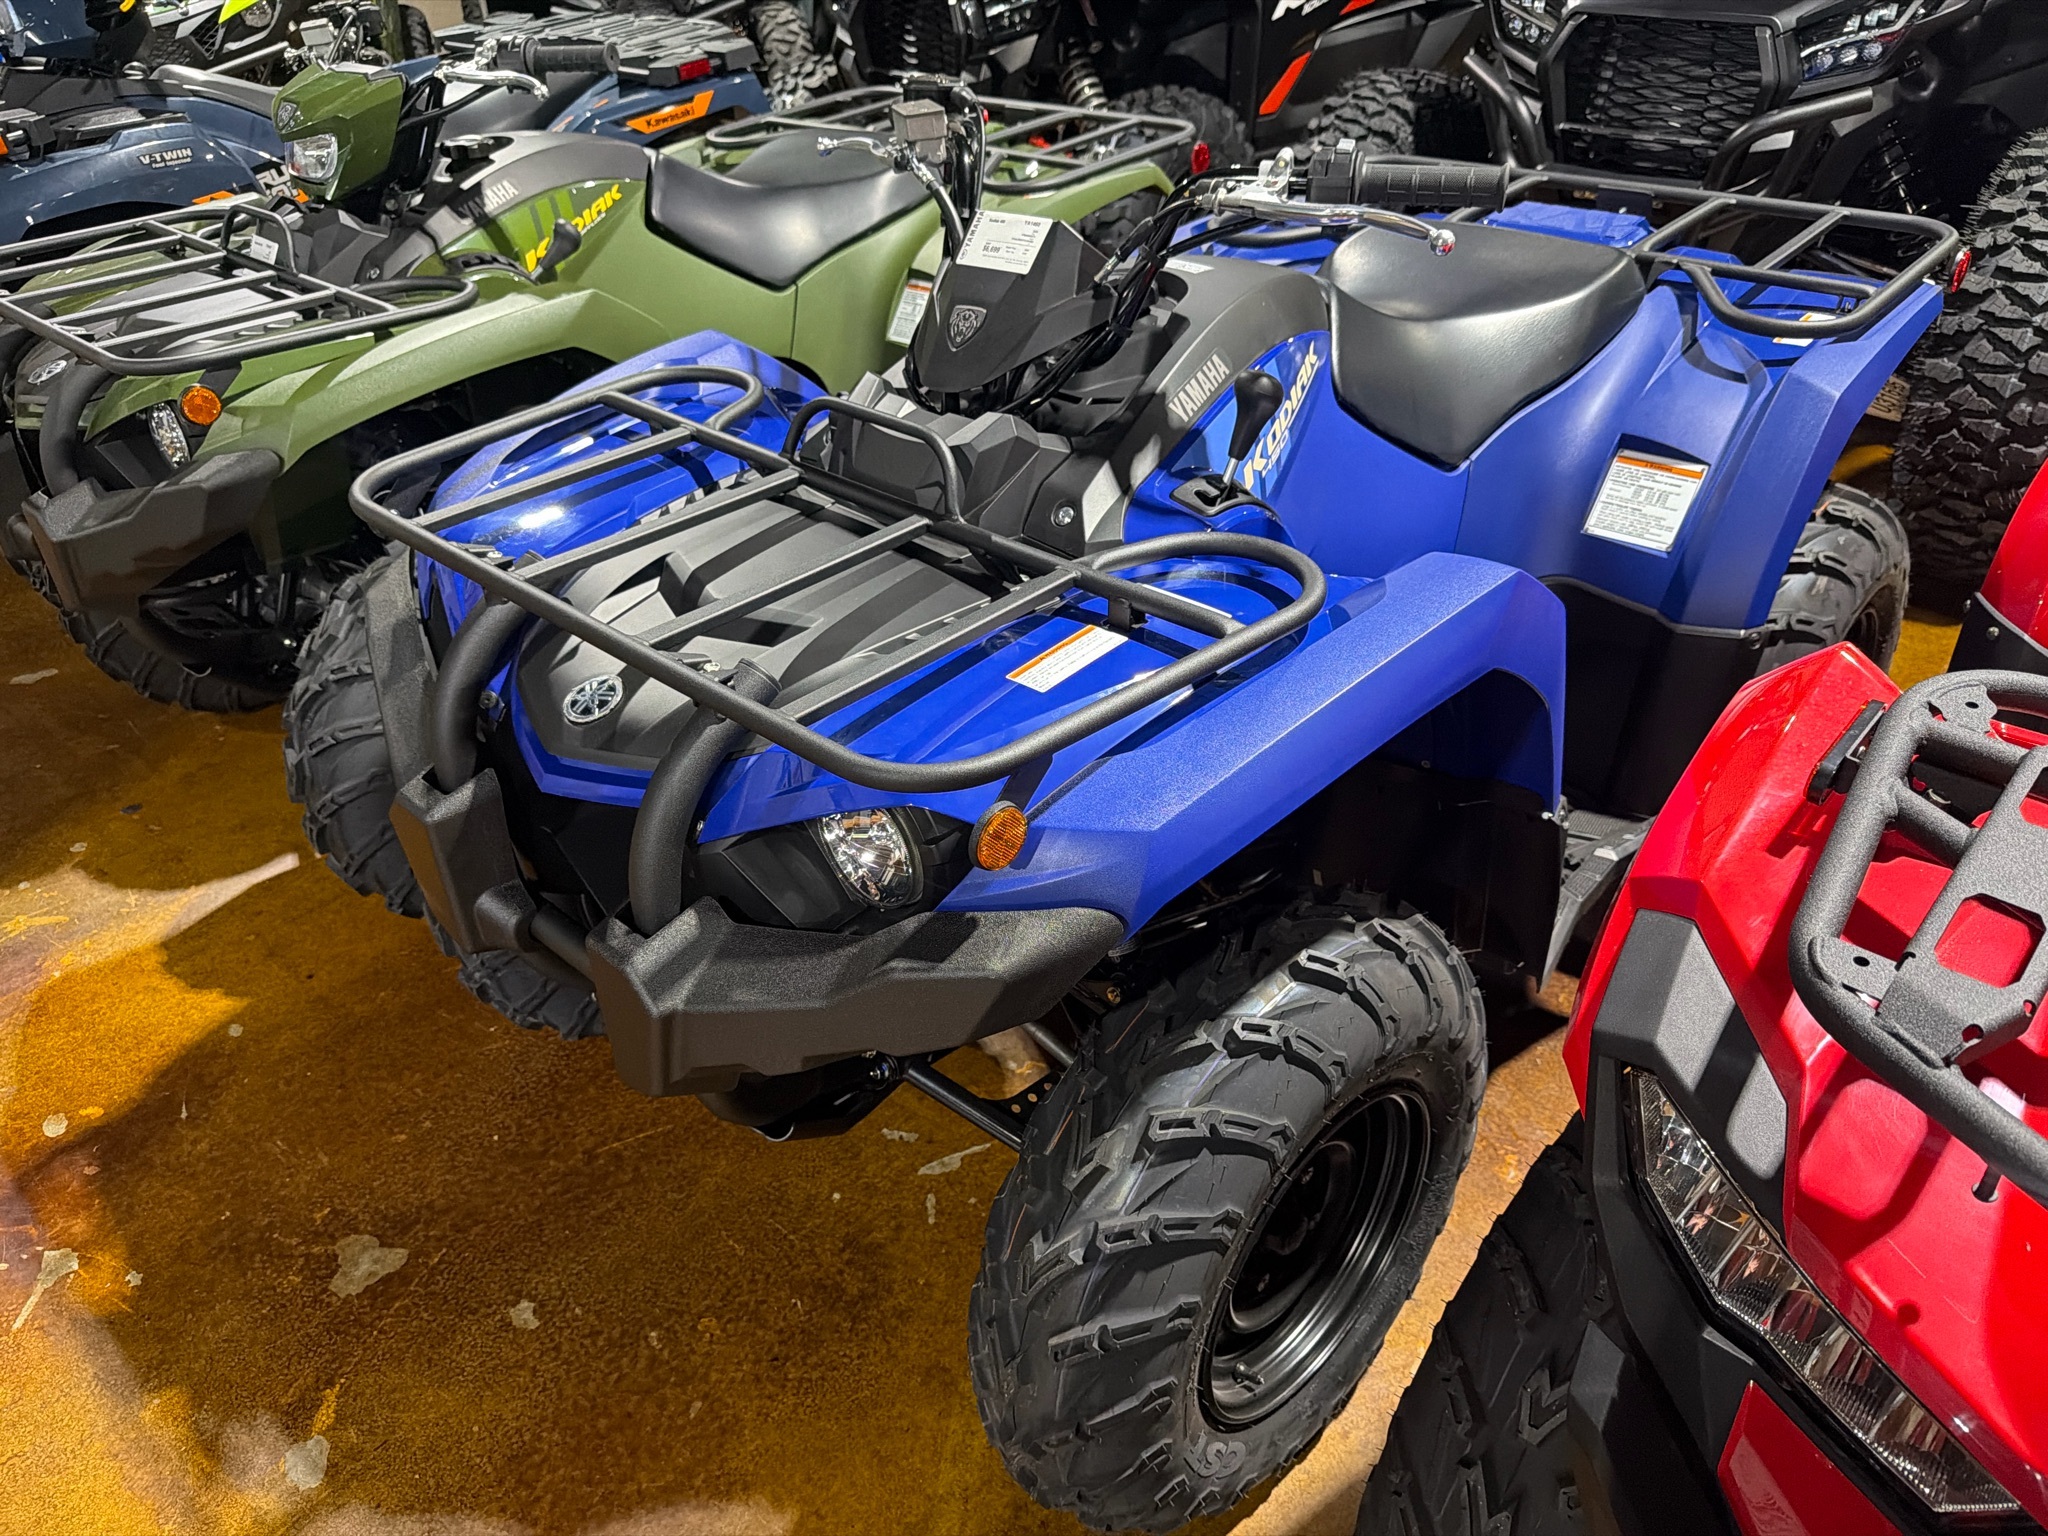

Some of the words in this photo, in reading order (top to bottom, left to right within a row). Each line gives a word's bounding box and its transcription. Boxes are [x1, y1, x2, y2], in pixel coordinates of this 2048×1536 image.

[645, 106, 696, 129] Kawasaki
[138, 148, 192, 165] V-TWIN
[459, 179, 519, 219] YAMAHA
[525, 183, 623, 273] KDIAK
[964, 211, 985, 249] YAMAHA
[1168, 353, 1230, 422] YAMAHA
[1243, 340, 1318, 490] KODIAK
[1261, 429, 1290, 478] 450
